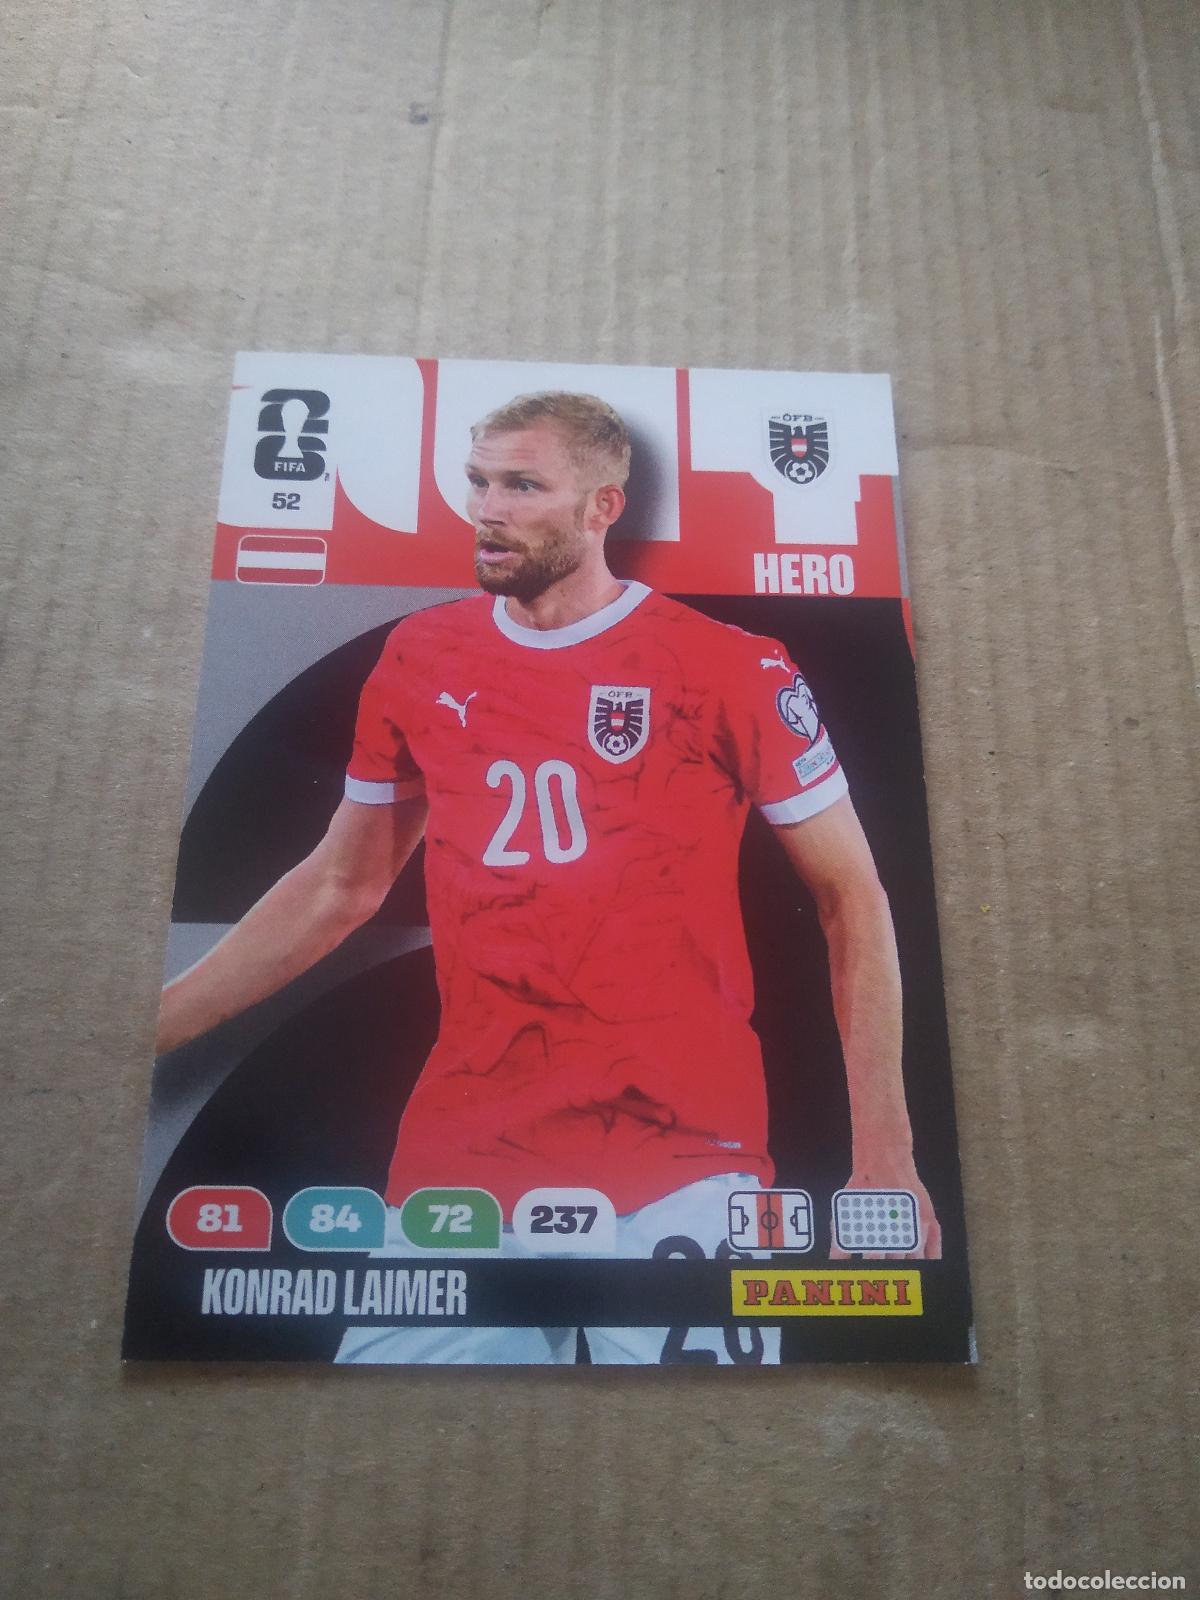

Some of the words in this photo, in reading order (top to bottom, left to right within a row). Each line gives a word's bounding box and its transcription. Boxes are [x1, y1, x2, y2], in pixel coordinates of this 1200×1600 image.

[274, 461, 306, 473] FIFA
[272, 492, 301, 511] 52
[753, 553, 855, 596] HERO
[482, 759, 588, 867] 20
[196, 1203, 243, 1233] 81
[309, 1203, 362, 1233] 84
[428, 1204, 474, 1234] 72
[530, 1205, 599, 1235] 237
[201, 1268, 337, 1316] KONRAD
[344, 1269, 467, 1316] LAIMER
[743, 1279, 912, 1307] PANINI
